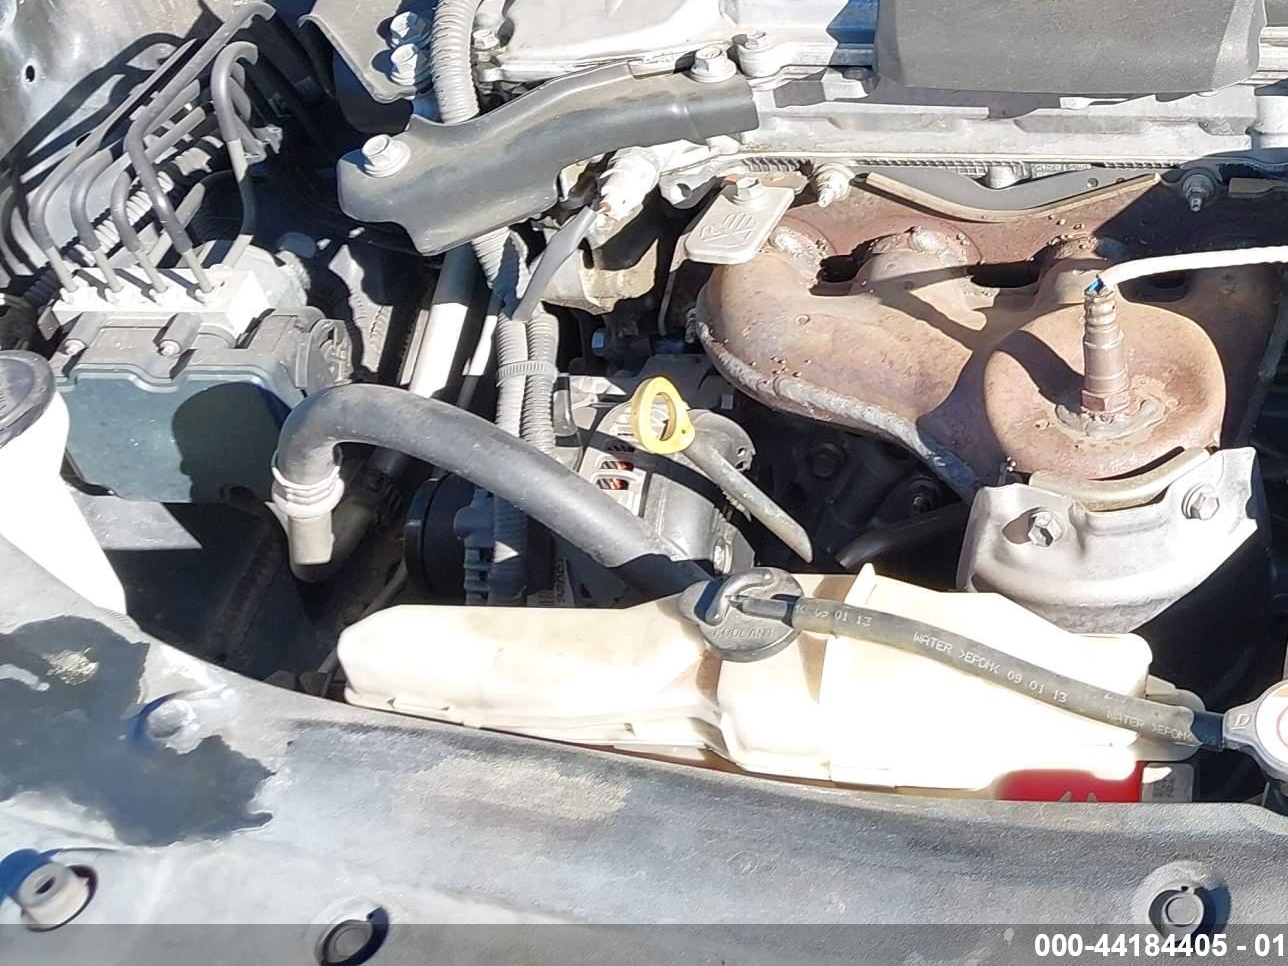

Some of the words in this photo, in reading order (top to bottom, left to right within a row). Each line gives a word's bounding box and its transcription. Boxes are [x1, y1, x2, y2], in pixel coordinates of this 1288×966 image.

[912, 631, 953, 655] WATER
[1006, 669, 1023, 684] 09
[1053, 689, 1068, 703] 13
